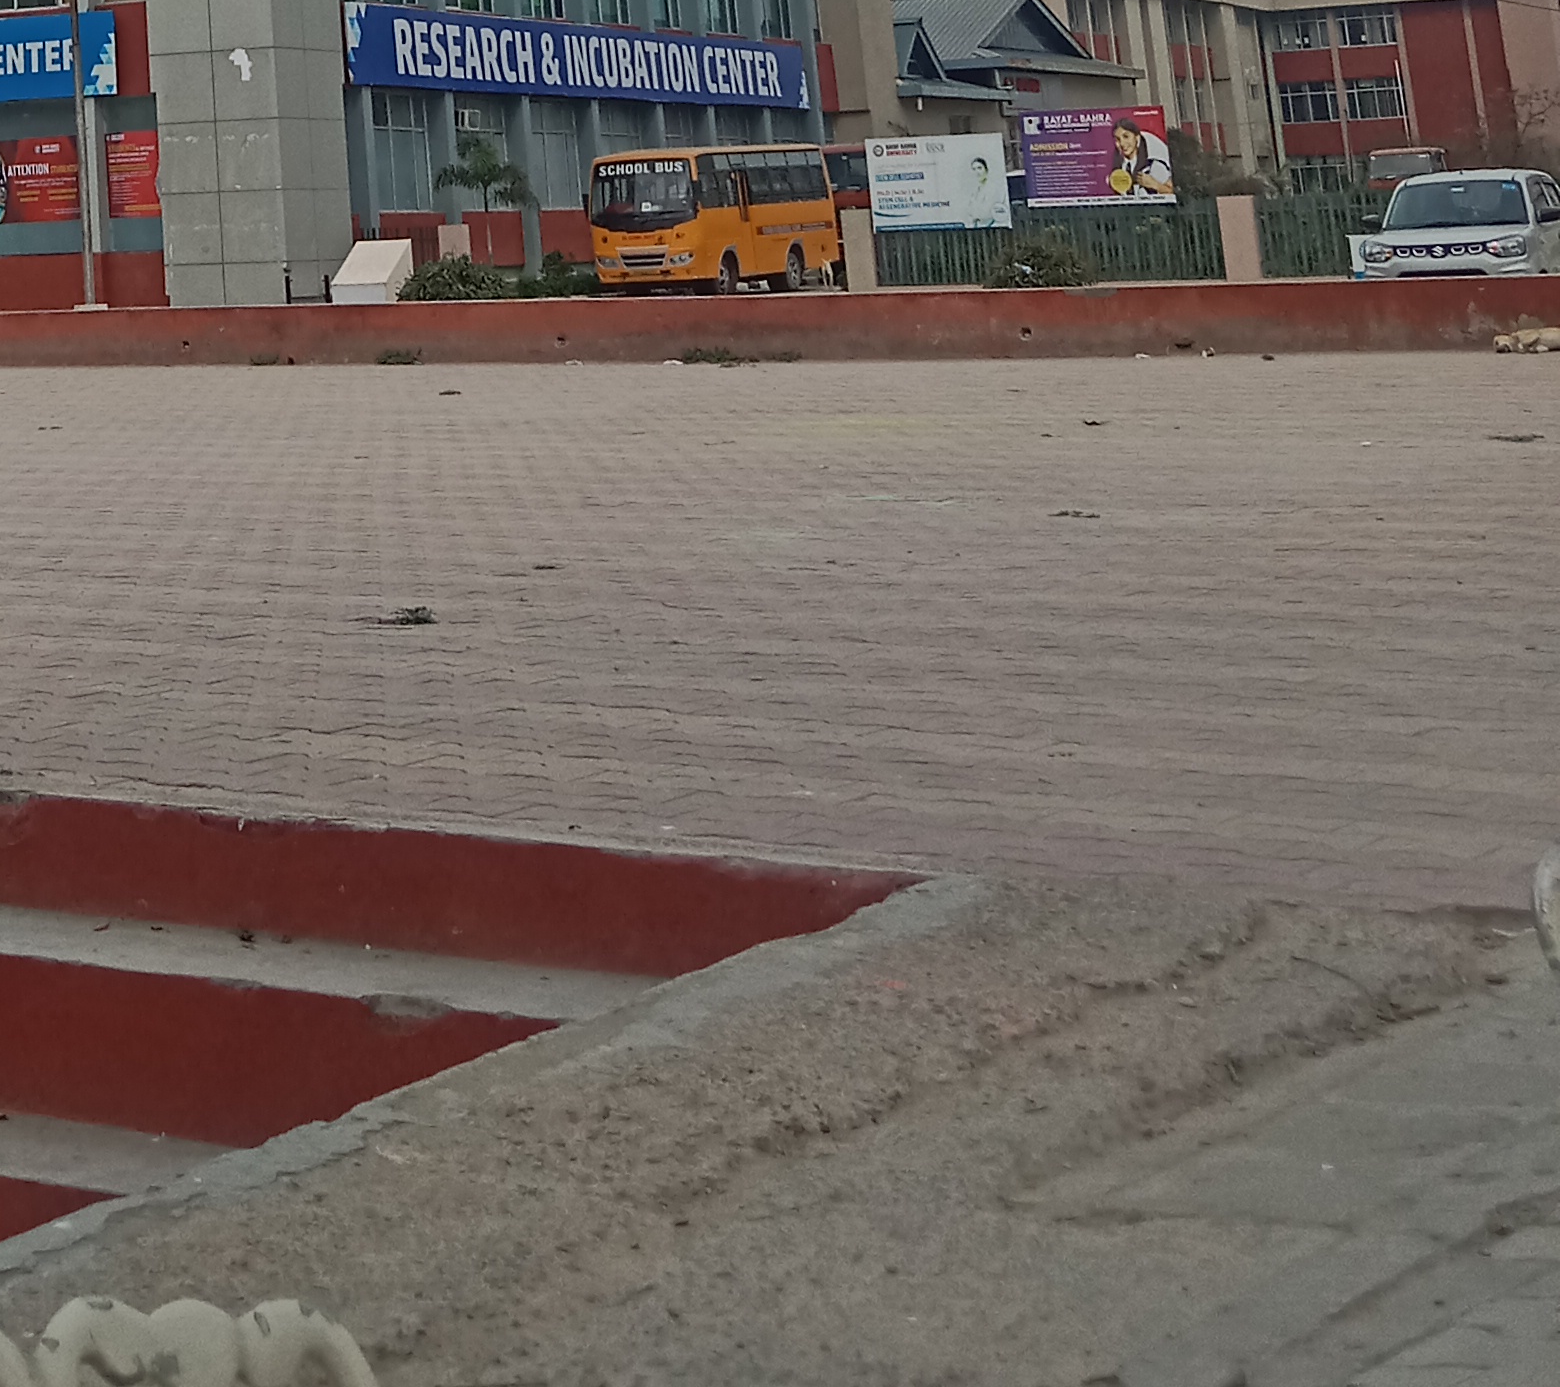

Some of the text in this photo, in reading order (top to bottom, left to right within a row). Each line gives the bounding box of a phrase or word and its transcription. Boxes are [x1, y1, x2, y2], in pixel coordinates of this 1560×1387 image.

[393, 18, 783, 97] RESEARCH & INCUBATION CENTER
[7, 163, 49, 178] ATTENTION
[599, 161, 684, 177] SCHOOL BUS
